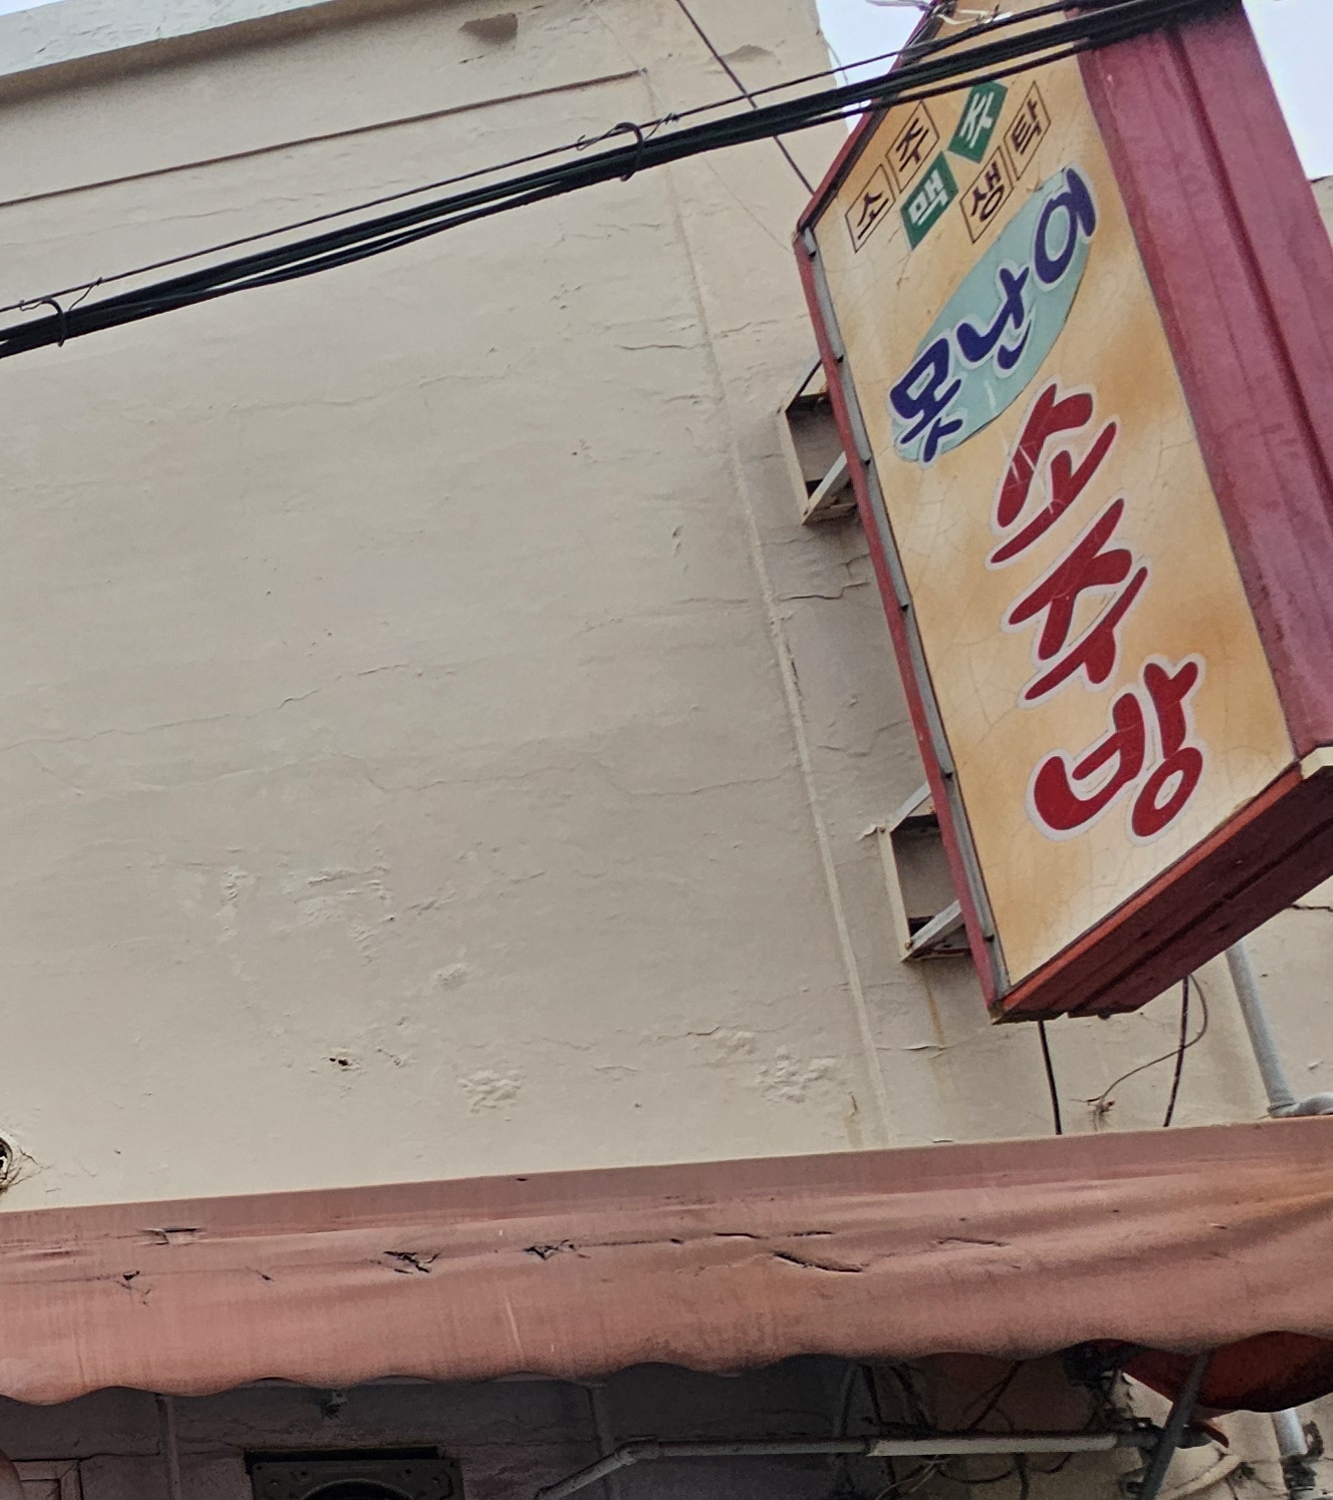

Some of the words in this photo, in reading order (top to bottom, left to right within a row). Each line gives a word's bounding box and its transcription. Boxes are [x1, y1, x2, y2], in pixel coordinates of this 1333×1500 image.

[857, 117, 930, 240] 소주
[971, 98, 1044, 222] 생탁
[888, 166, 1098, 463] 못난이
[989, 382, 1203, 840] 소주방
